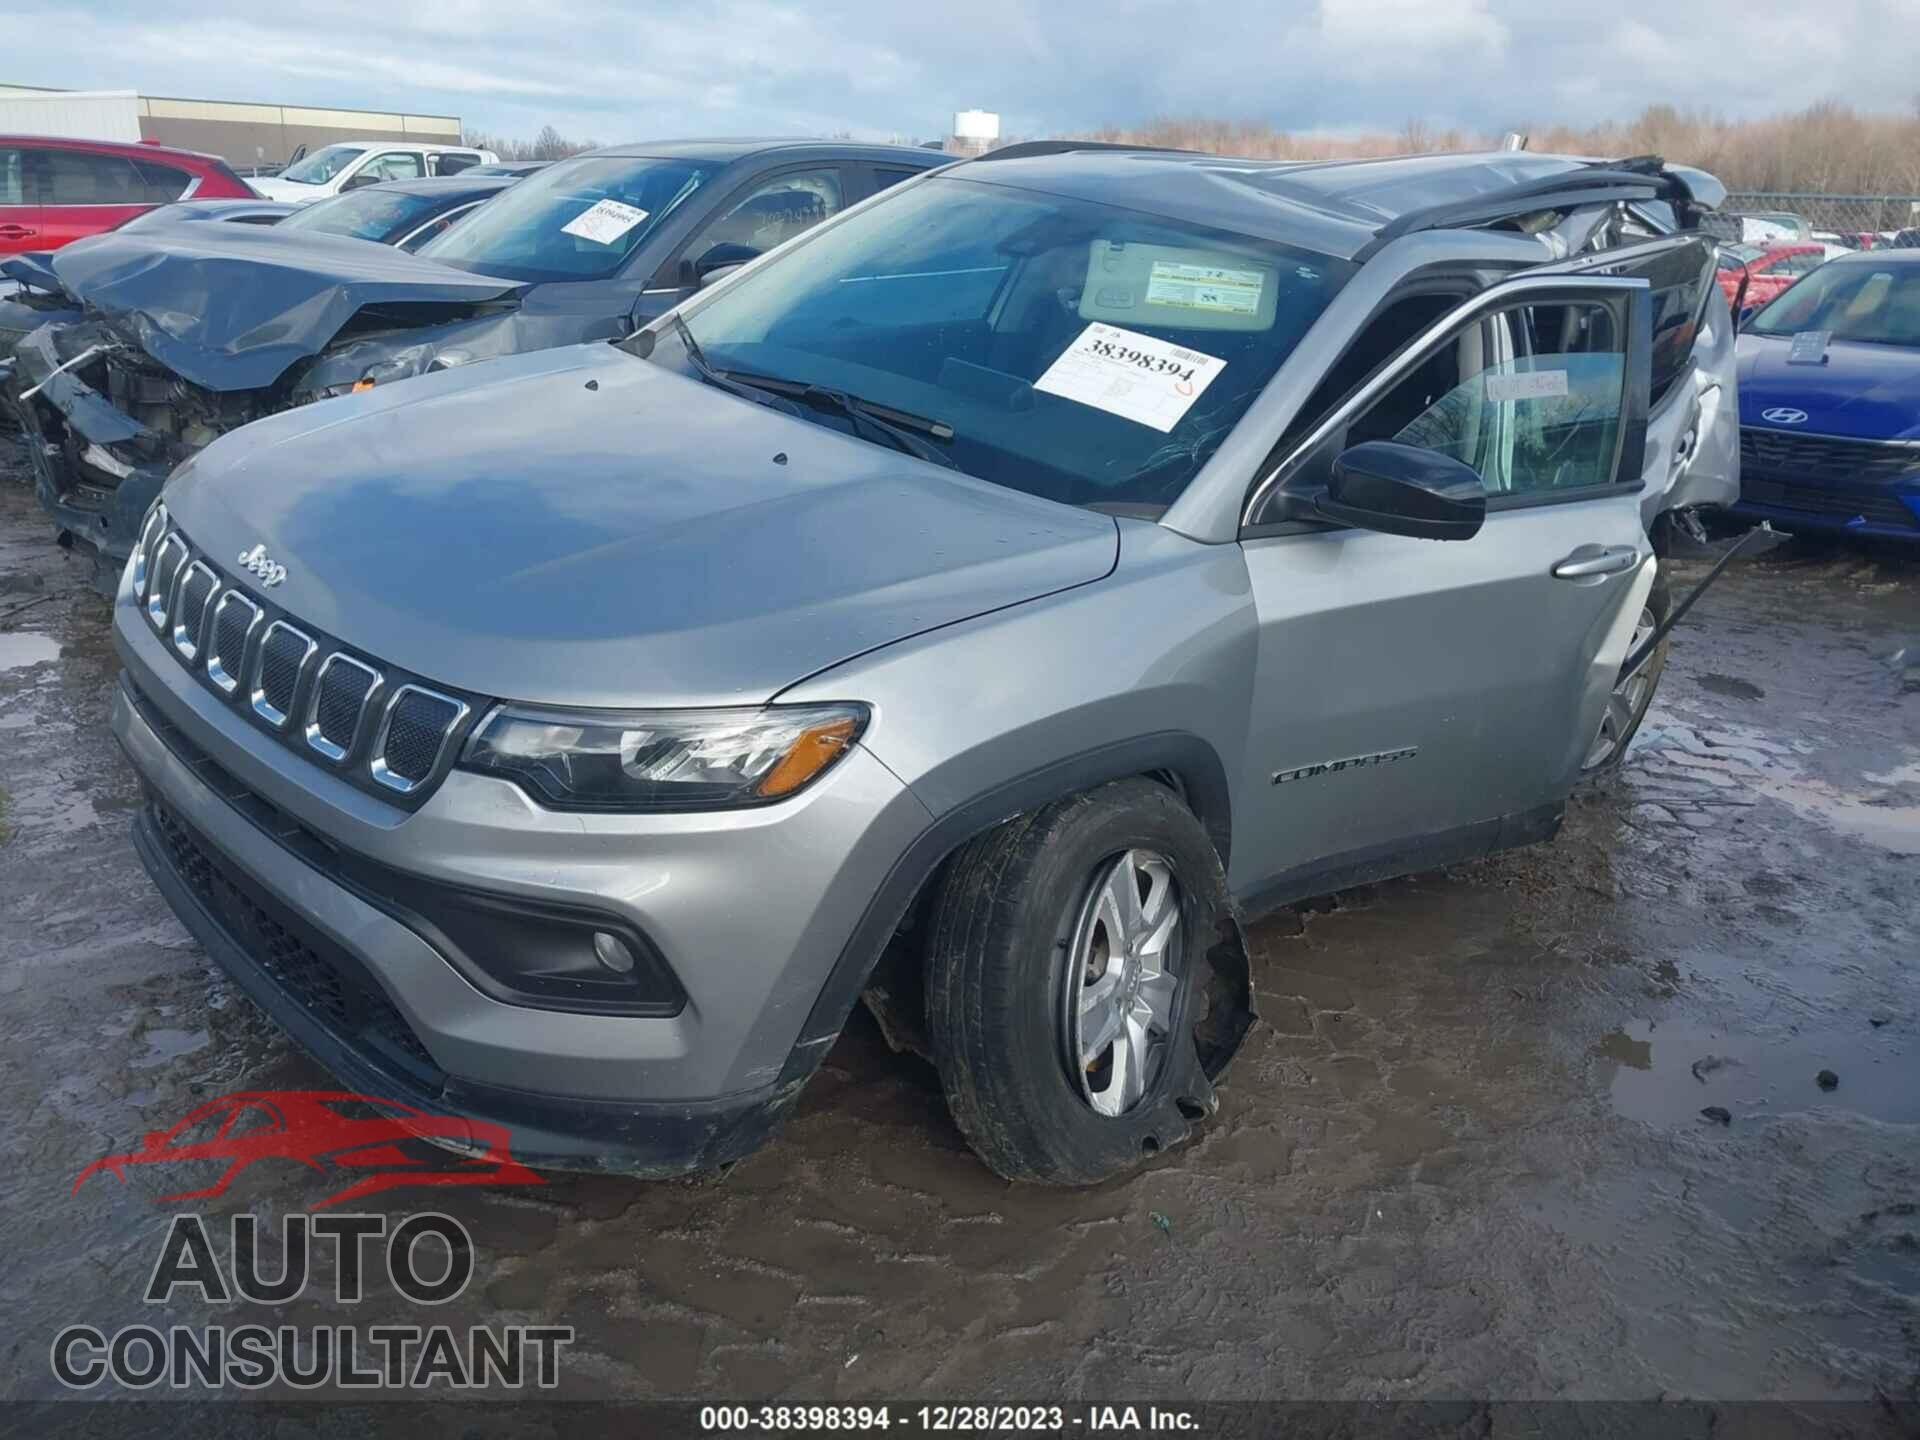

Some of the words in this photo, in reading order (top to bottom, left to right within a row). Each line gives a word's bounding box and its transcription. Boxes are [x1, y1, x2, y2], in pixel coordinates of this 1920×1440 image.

[1084, 338, 1196, 383] 38398394
[237, 543, 288, 589] Jeep
[1271, 745, 1419, 786] COMPASS
